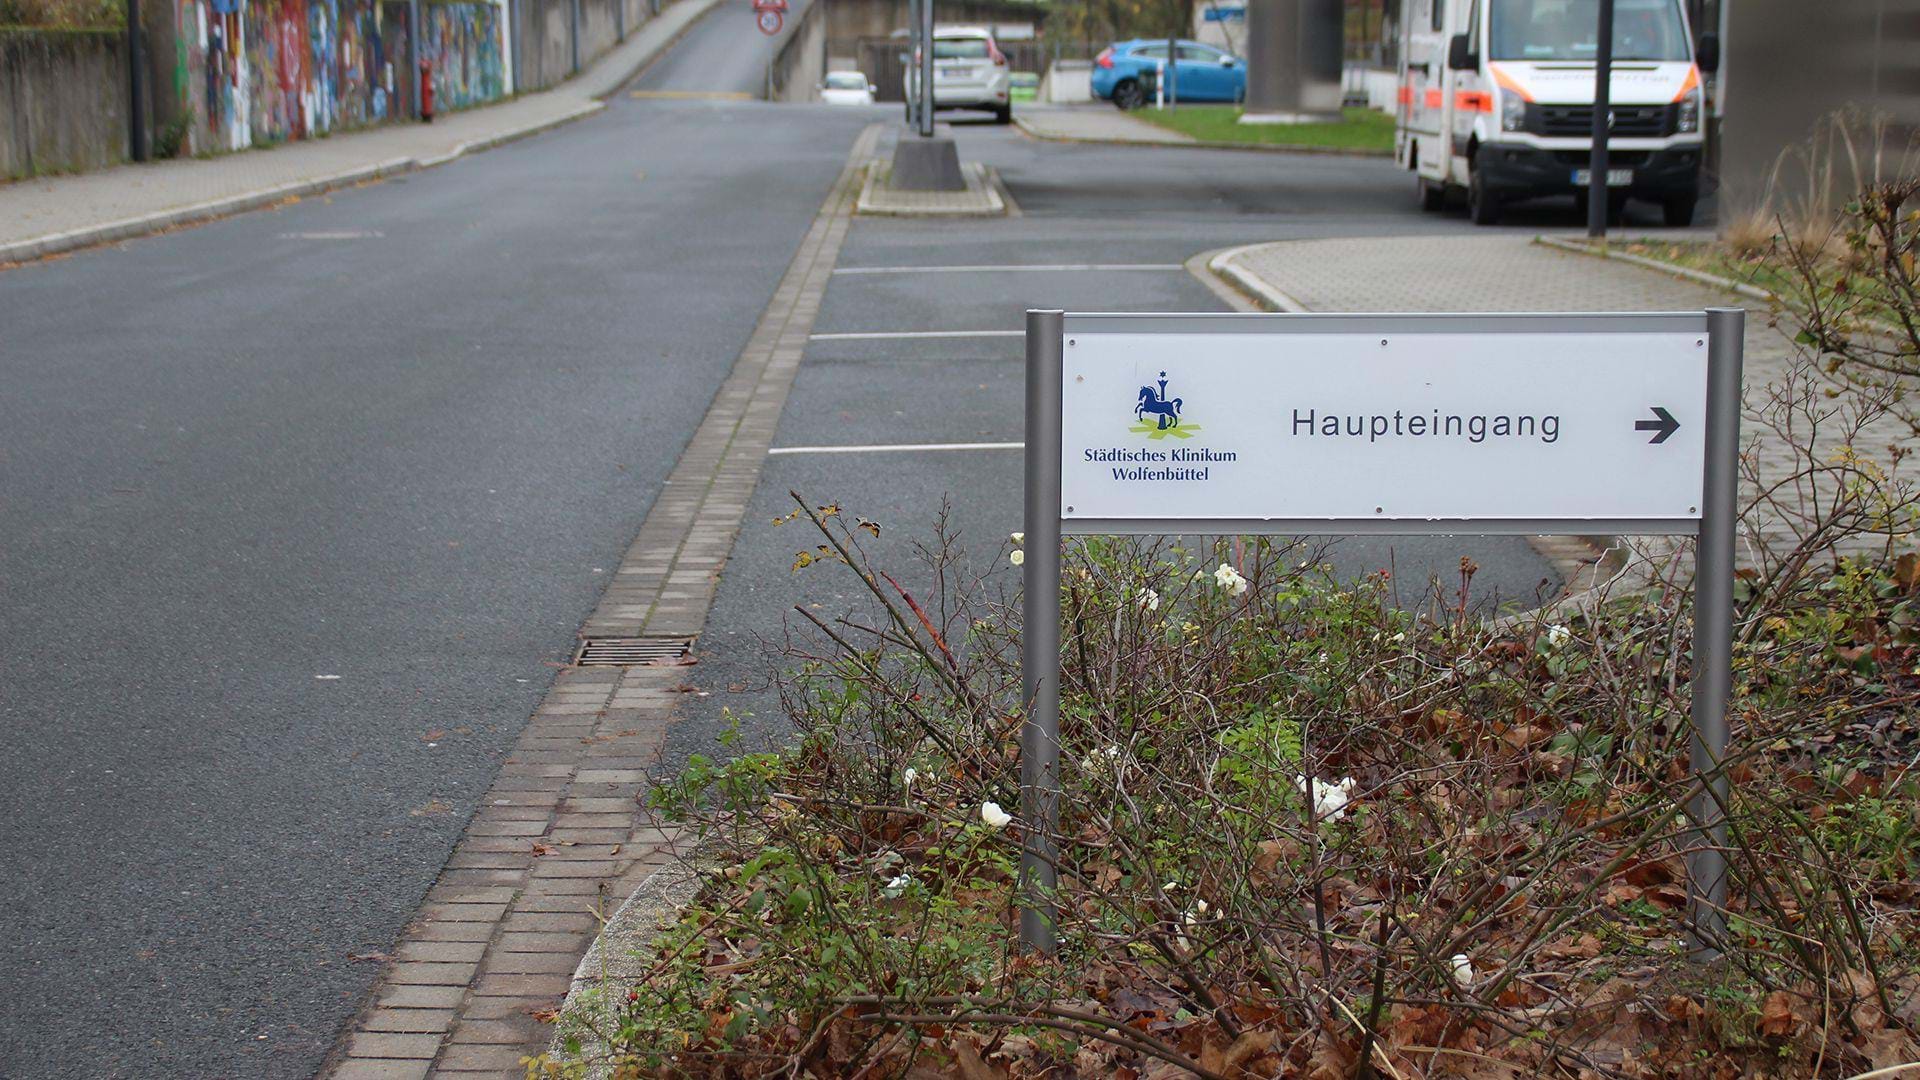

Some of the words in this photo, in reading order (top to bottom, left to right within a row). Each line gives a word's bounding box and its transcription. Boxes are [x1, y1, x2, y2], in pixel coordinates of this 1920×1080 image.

[1292, 408, 1560, 443] Haupteingang
[1084, 447, 1166, 462] Städtisches
[1171, 447, 1237, 462] Klinikum
[1112, 466, 1209, 481] Wolfenbüttel
